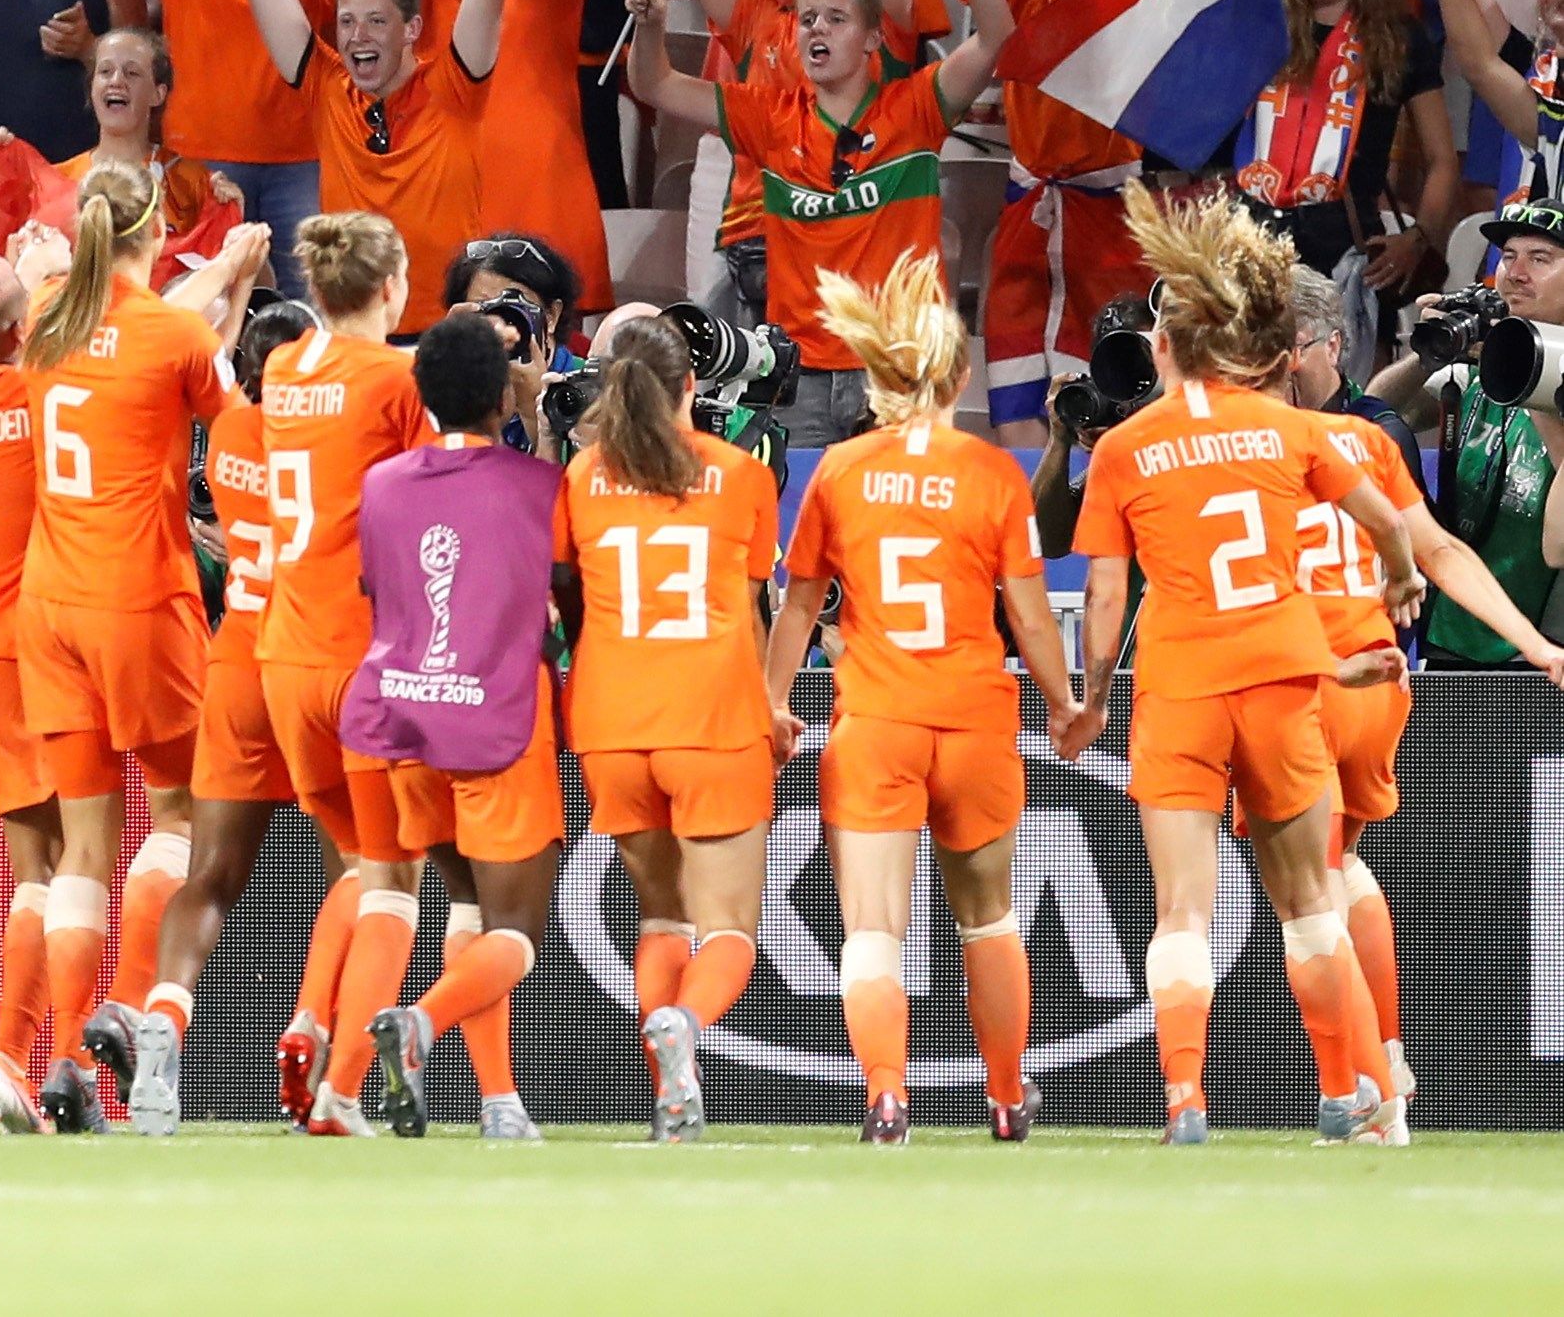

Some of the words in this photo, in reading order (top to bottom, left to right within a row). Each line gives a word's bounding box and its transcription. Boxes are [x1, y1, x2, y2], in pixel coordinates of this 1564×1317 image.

[43, 384, 93, 498] 6
[215, 450, 269, 498] BEERE
[863, 470, 916, 505] VAN
[921, 476, 956, 510] ES
[1133, 440, 1178, 478] VAN
[1177, 427, 1285, 468] LUNTEREN
[269, 450, 315, 563] 9
[1198, 489, 1276, 610] 2
[596, 525, 710, 640] 13
[879, 536, 947, 651] 5
[379, 678, 441, 703] RANCE
[440, 683, 485, 706] 2019
